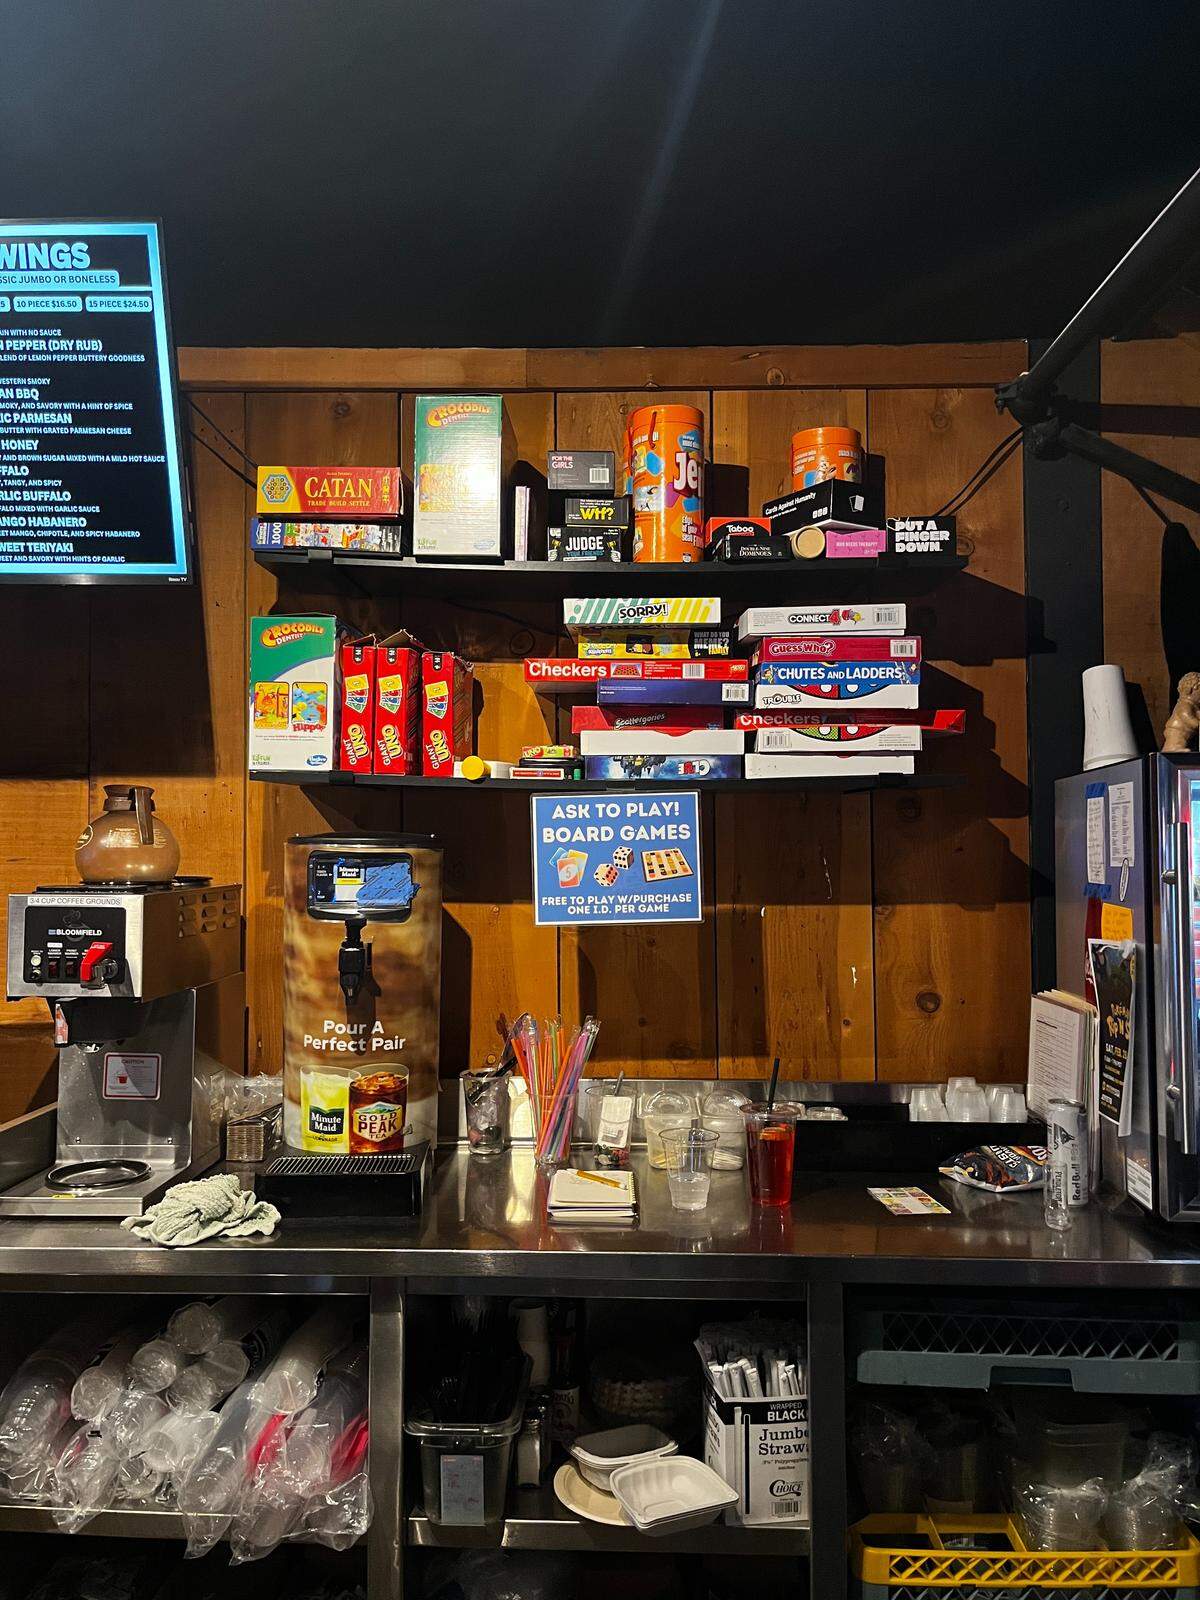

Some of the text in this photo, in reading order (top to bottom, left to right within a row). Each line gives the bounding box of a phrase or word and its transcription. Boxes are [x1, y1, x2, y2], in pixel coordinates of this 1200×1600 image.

[0, 242, 90, 269] WINGS
[19, 275, 115, 284] JUMBO OR BONELESS
[28, 300, 50, 308] PIECE
[51, 300, 77, 309] $16.50
[89, 300, 149, 309] 15 PIECE $24.50
[6, 340, 103, 352] PEPPER (DRY RUB)
[15, 388, 39, 400] BBQ
[36, 402, 62, 410] SAVORY
[63, 402, 80, 410] WITH
[13, 413, 72, 424] PARMESAN
[1, 439, 39, 450] HONEY
[552, 461, 574, 469] GIRLS
[43, 479, 62, 487] SPICY
[304, 476, 374, 499] CATAN
[22, 490, 71, 501] BUFFALO
[765, 505, 778, 515] Cards
[778, 499, 795, 511] Against
[794, 491, 817, 505] Humanity
[28, 516, 87, 527] HABANERO
[895, 519, 938, 531] PUT A
[271, 522, 283, 545] 1000
[726, 524, 755, 533] Taboo
[895, 530, 951, 542] FINGER
[26, 542, 74, 552] TERIYAKI
[565, 536, 604, 551] JUDGE
[619, 603, 667, 619] SORRY!
[789, 613, 830, 624] CONNECT
[829, 609, 841, 625] 4
[261, 622, 325, 647] CROCODILE
[694, 638, 730, 650] MEME?
[529, 662, 607, 677] Checkers
[777, 667, 902, 680] CHUTES AND LADDERS
[762, 694, 802, 705] TROUBLE
[615, 712, 665, 729] Scattergories
[348, 723, 370, 759] UNO
[381, 723, 404, 759] UNO
[430, 729, 452, 763] UNO
[343, 738, 358, 765] GIANT
[376, 738, 391, 766] GIANT
[425, 743, 440, 770] GIANT
[552, 801, 680, 819] ASK TO PLAY!
[542, 824, 691, 843] BOARD GAMES
[542, 893, 692, 906] FREE TO PLAY W/PURCHASE
[567, 903, 669, 915] ONE I.D. PER GAME
[56, 928, 103, 936] BLOOMFIELD
[323, 1020, 384, 1034] Pour A
[303, 1034, 406, 1052] Perfect Pair
[311, 1111, 342, 1124] Minute
[358, 1111, 397, 1122] GOLD
[314, 1121, 337, 1132] Maid
[358, 1119, 397, 1134] PEAK
[1071, 1163, 1081, 1182] Bull
[1071, 1183, 1081, 1201] Red
[770, 1402, 802, 1410] WRAPPED
[767, 1409, 806, 1421] BLACK
